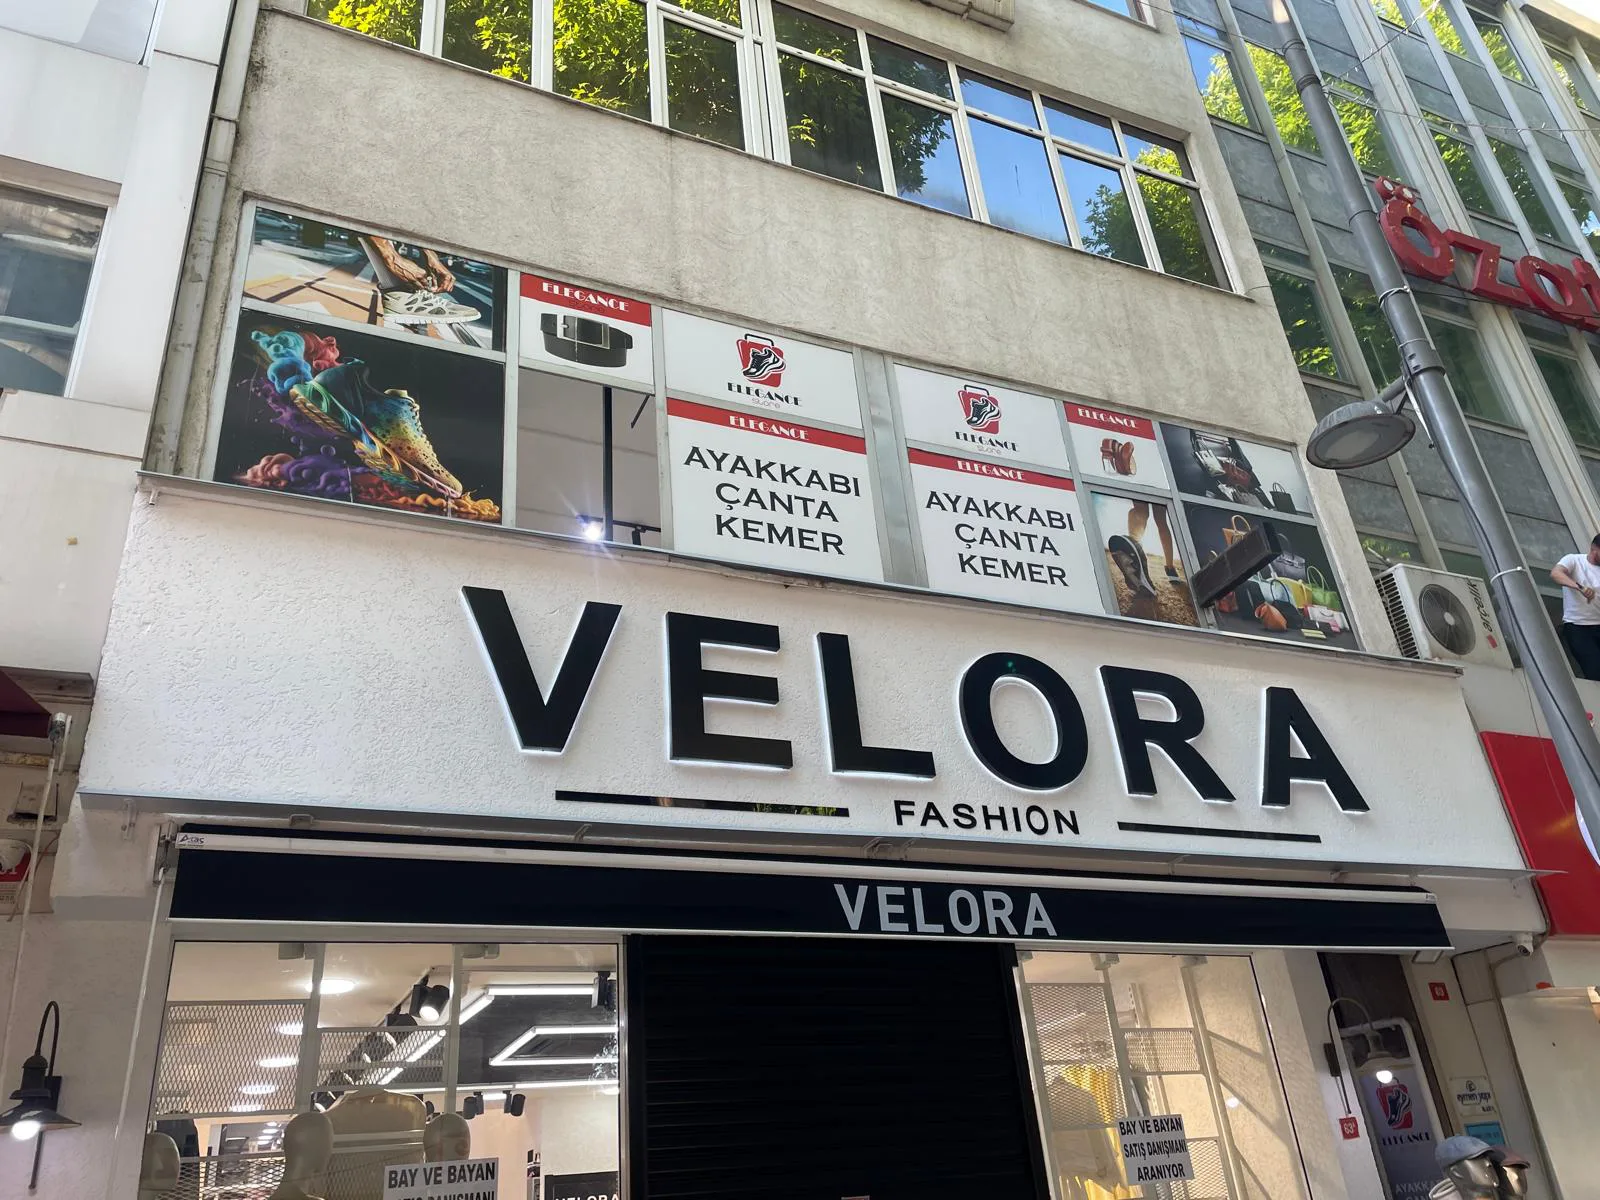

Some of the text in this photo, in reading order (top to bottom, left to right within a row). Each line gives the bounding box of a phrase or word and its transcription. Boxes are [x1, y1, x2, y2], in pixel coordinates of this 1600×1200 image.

[542, 282, 629, 312] ELEGANCE
[727, 382, 803, 407] ELEGANCE
[729, 415, 809, 441] ELEGANCE
[1078, 407, 1137, 429] ELEGANCE
[955, 431, 1020, 452] ELEGANCE
[683, 445, 861, 498] AYAKKABI
[957, 460, 1025, 481] ELEGANCE
[715, 482, 839, 523] ÇANTA
[925, 490, 1076, 532] AYAKKABI
[715, 514, 846, 556] KEMER
[954, 523, 1061, 557] ÇANTA
[958, 552, 1070, 587] KEMER
[461, 585, 1371, 814] VELORA
[894, 800, 1081, 837] FASHION
[833, 882, 1058, 937] VELORA
[1118, 1117, 1184, 1136] BAY VE BAYAN
[1123, 1139, 1188, 1160] SATIŞ DANIŞMANI
[388, 1162, 496, 1189] BAY VE BAYAN
[1137, 1163, 1186, 1182] ARANIYOR
